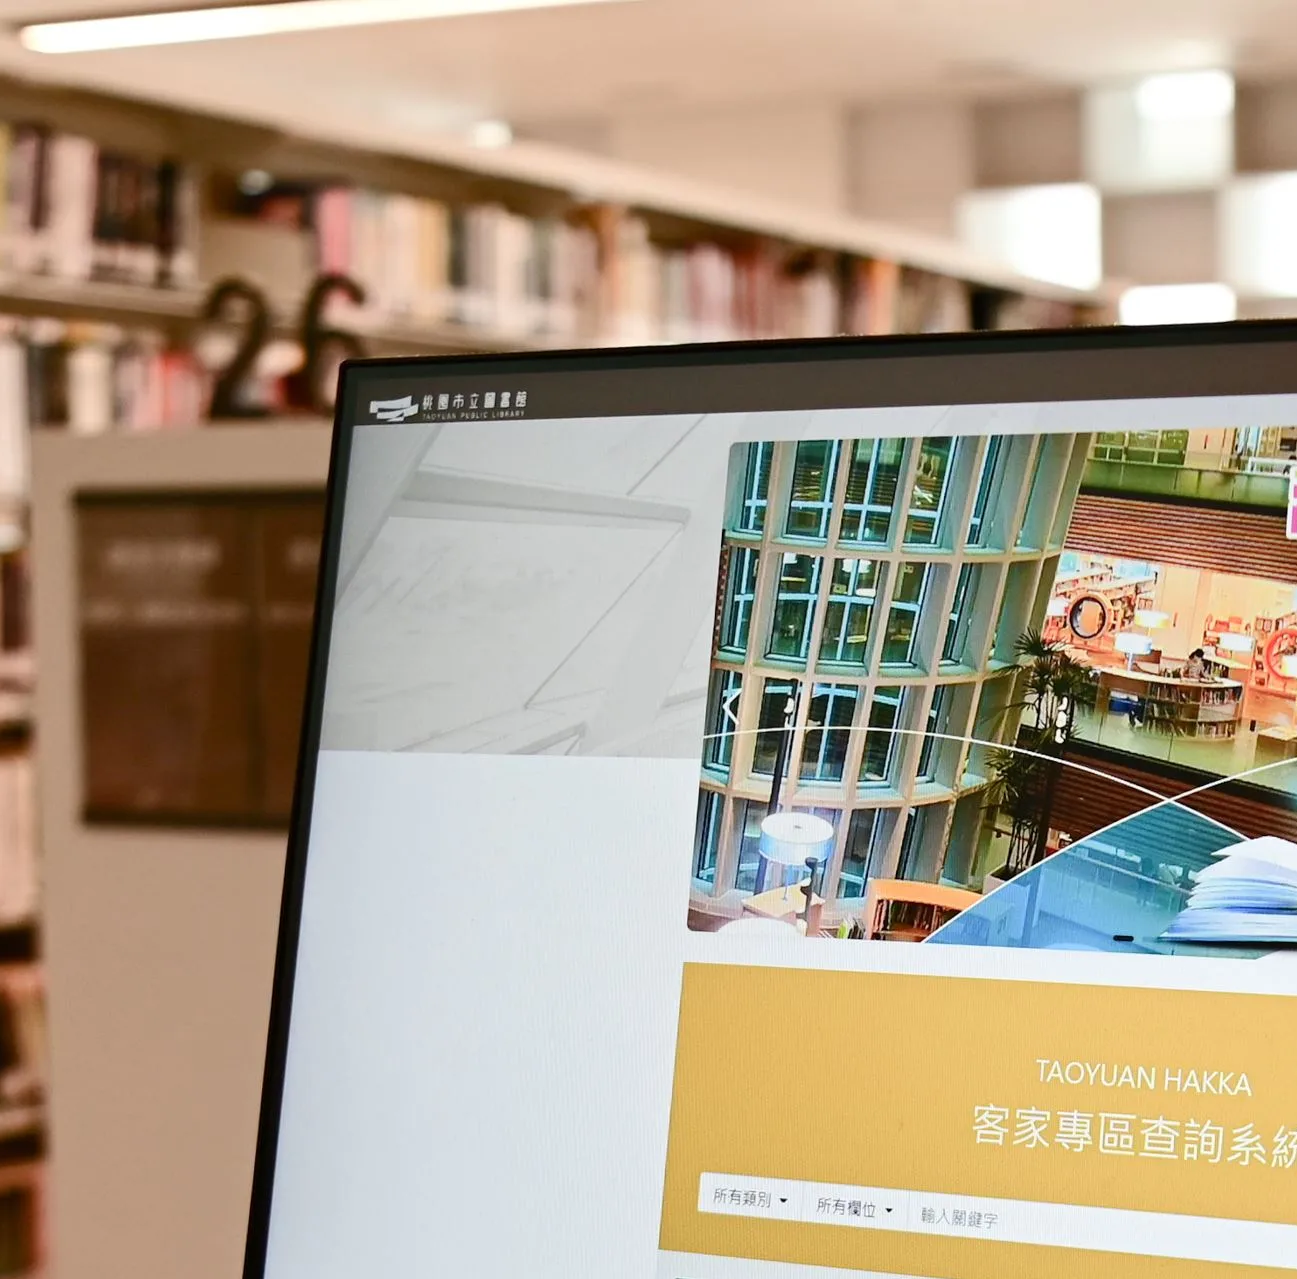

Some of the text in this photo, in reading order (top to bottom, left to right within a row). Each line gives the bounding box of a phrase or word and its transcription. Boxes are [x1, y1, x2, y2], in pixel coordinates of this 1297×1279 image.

[205, 276, 367, 417] 26
[1036, 1058, 1253, 1097] TAOYUAN HAKKA
[713, 1187, 771, 1209] 所有類別
